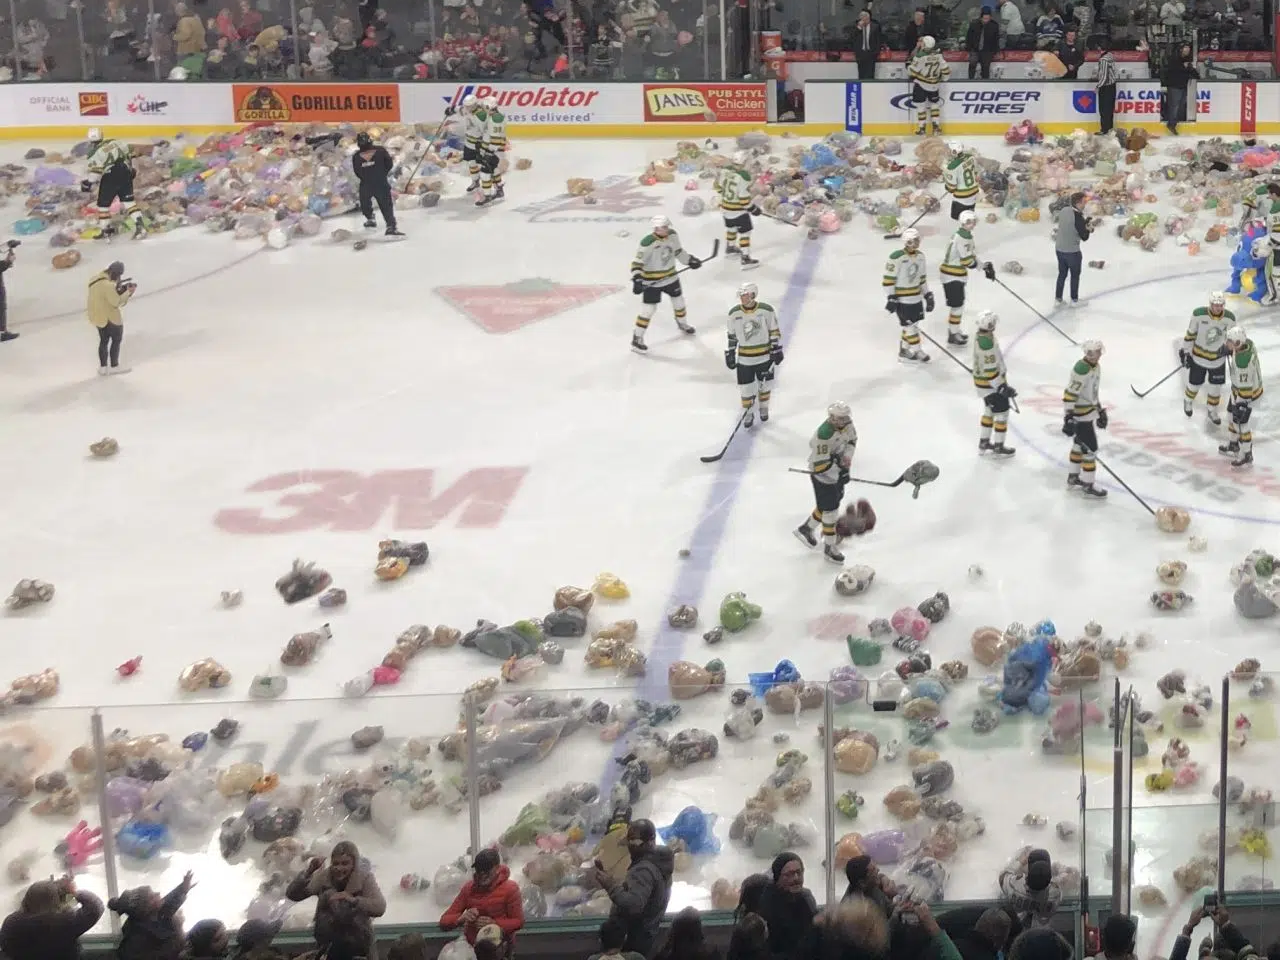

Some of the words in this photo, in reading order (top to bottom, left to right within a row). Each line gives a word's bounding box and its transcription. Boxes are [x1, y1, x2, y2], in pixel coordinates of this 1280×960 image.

[925, 61, 940, 78] 72
[81, 94, 107, 104] CIBC
[475, 86, 599, 108] Purolator
[708, 90, 733, 98] PUB
[736, 90, 765, 98] STYL
[949, 91, 1041, 103] COOPER
[30, 96, 71, 104] OFFICIAL
[291, 95, 352, 112] GORILLA
[357, 95, 394, 112] GLUE
[654, 91, 705, 112] JANES
[716, 98, 766, 109] Chicken
[1244, 86, 1252, 121] CCM
[46, 104, 72, 112] BANK
[139, 100, 168, 113] CHL
[961, 103, 1028, 114] TIRES
[244, 110, 286, 120] GORILLA
[538, 112, 592, 122] delivered
[1240, 374, 1248, 382] 17
[212, 465, 531, 534] 3M
